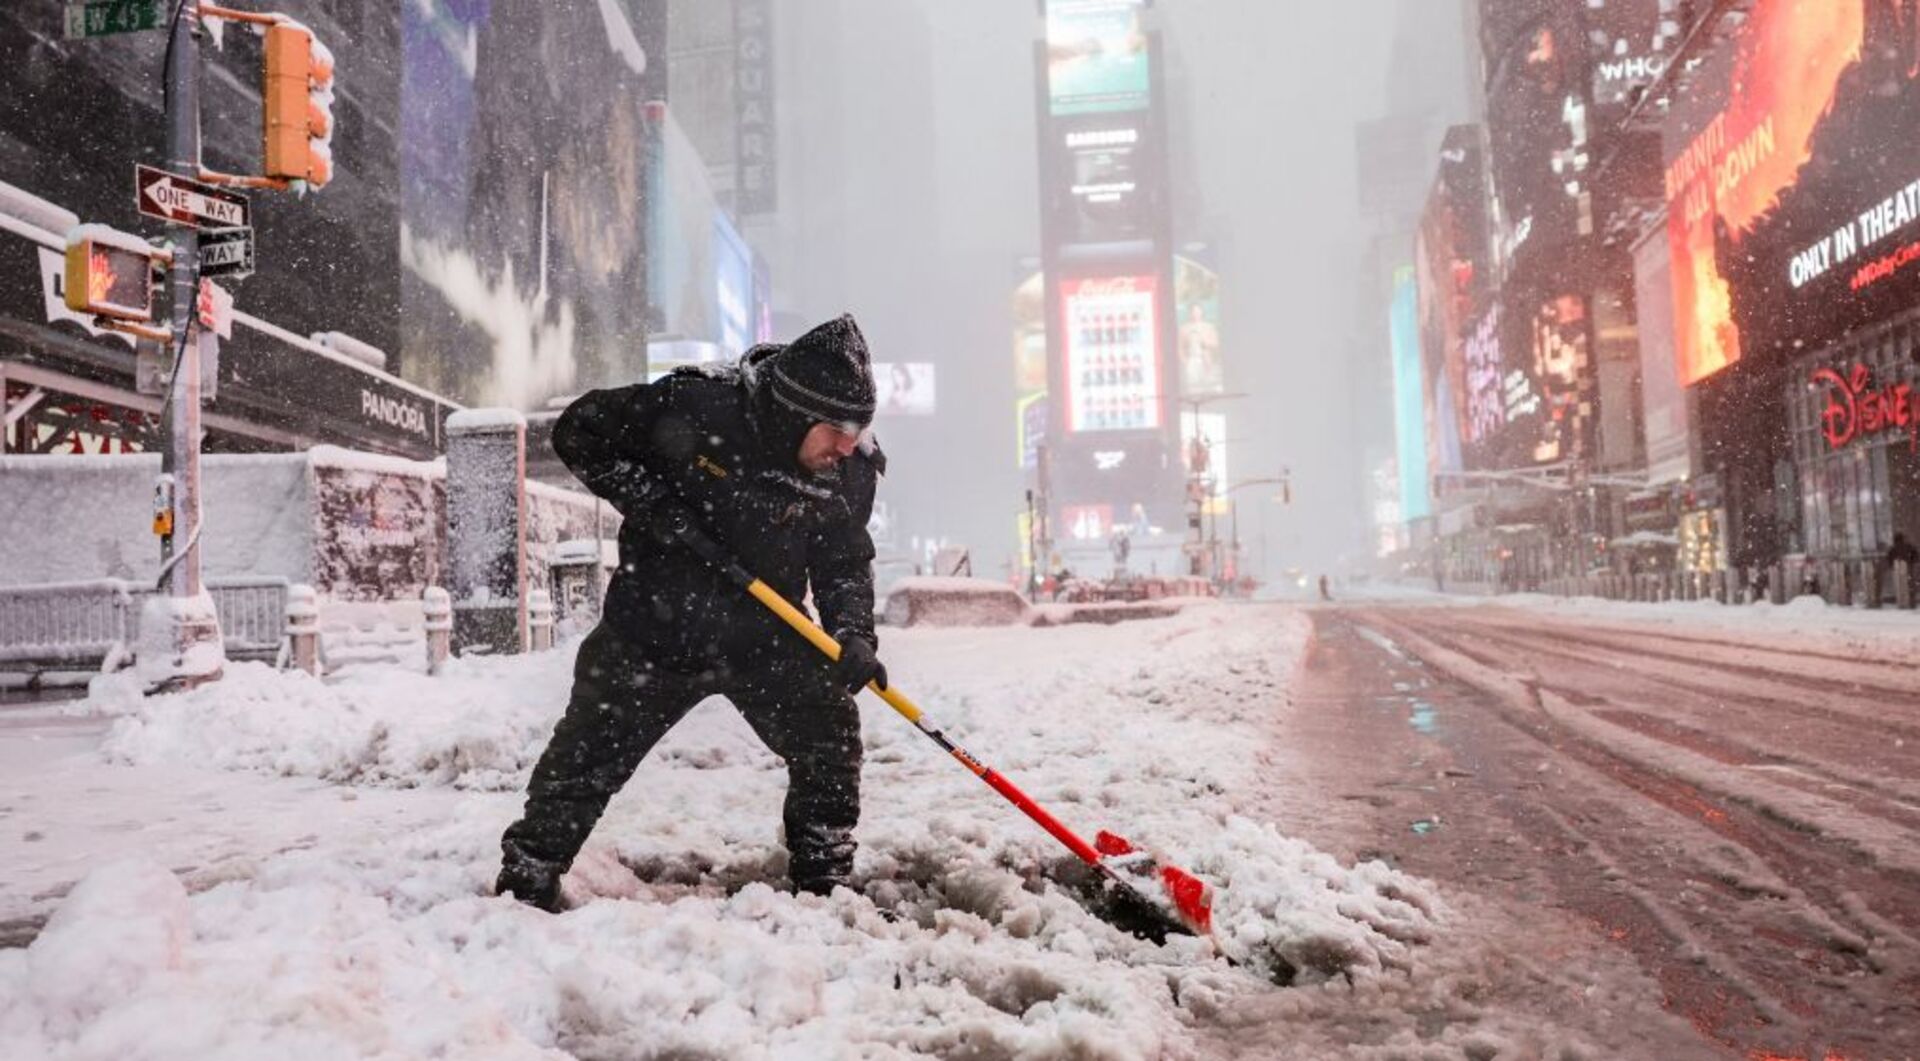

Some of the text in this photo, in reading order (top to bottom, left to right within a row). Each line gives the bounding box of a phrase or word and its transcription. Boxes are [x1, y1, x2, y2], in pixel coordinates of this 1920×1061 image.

[90, 7, 110, 31] W
[118, 3, 139, 29] 45
[739, 4, 764, 190] SQUARE
[1716, 114, 1773, 202] DOWN
[156, 186, 236, 220] ONE WAY
[200, 245, 237, 265] WAY
[1790, 236, 1830, 288] ONLY
[1834, 222, 1856, 262] IN
[361, 389, 428, 438] PANDORA
